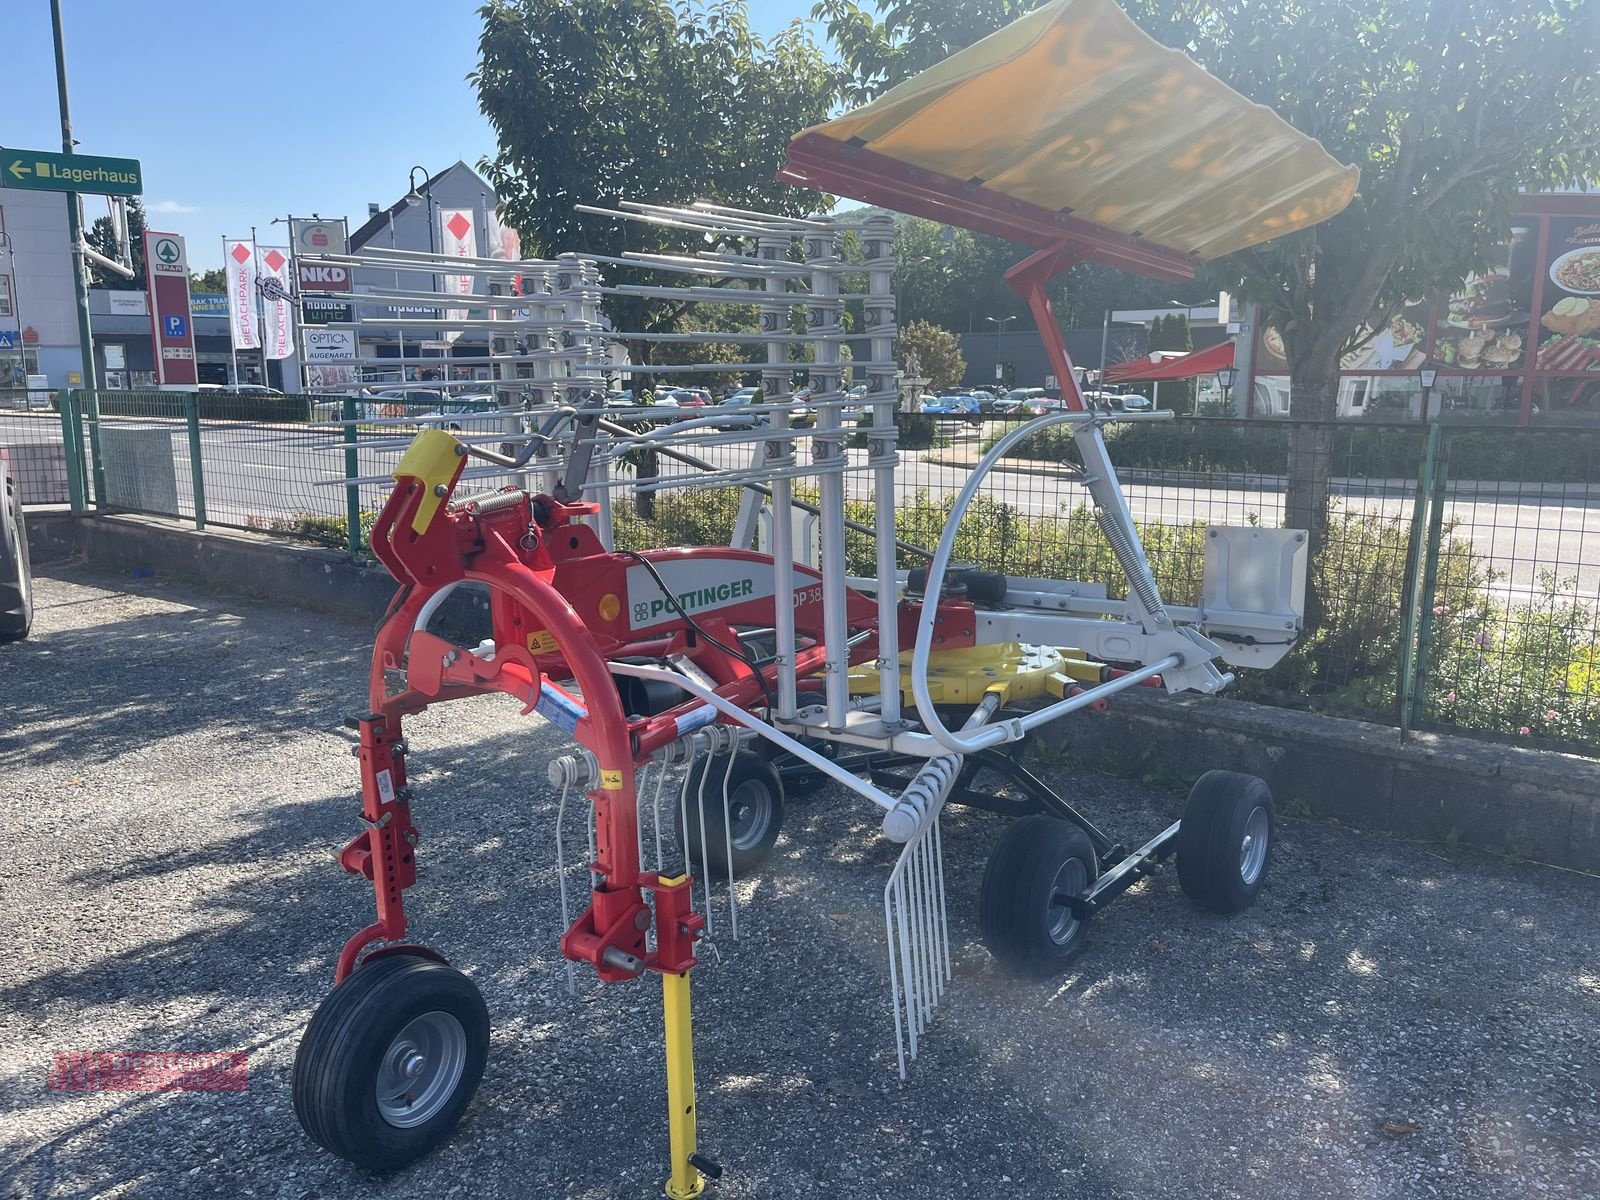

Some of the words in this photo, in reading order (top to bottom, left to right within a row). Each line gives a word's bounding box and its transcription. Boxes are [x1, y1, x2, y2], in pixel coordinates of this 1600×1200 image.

[52, 163, 138, 184] Lagerhaus
[156, 264, 182, 272] SPAR
[301, 266, 346, 282] NKD
[239, 267, 251, 346] PIELACHPARK
[311, 311, 344, 320] KING
[170, 317, 180, 330] P
[309, 333, 349, 344] OPTICA
